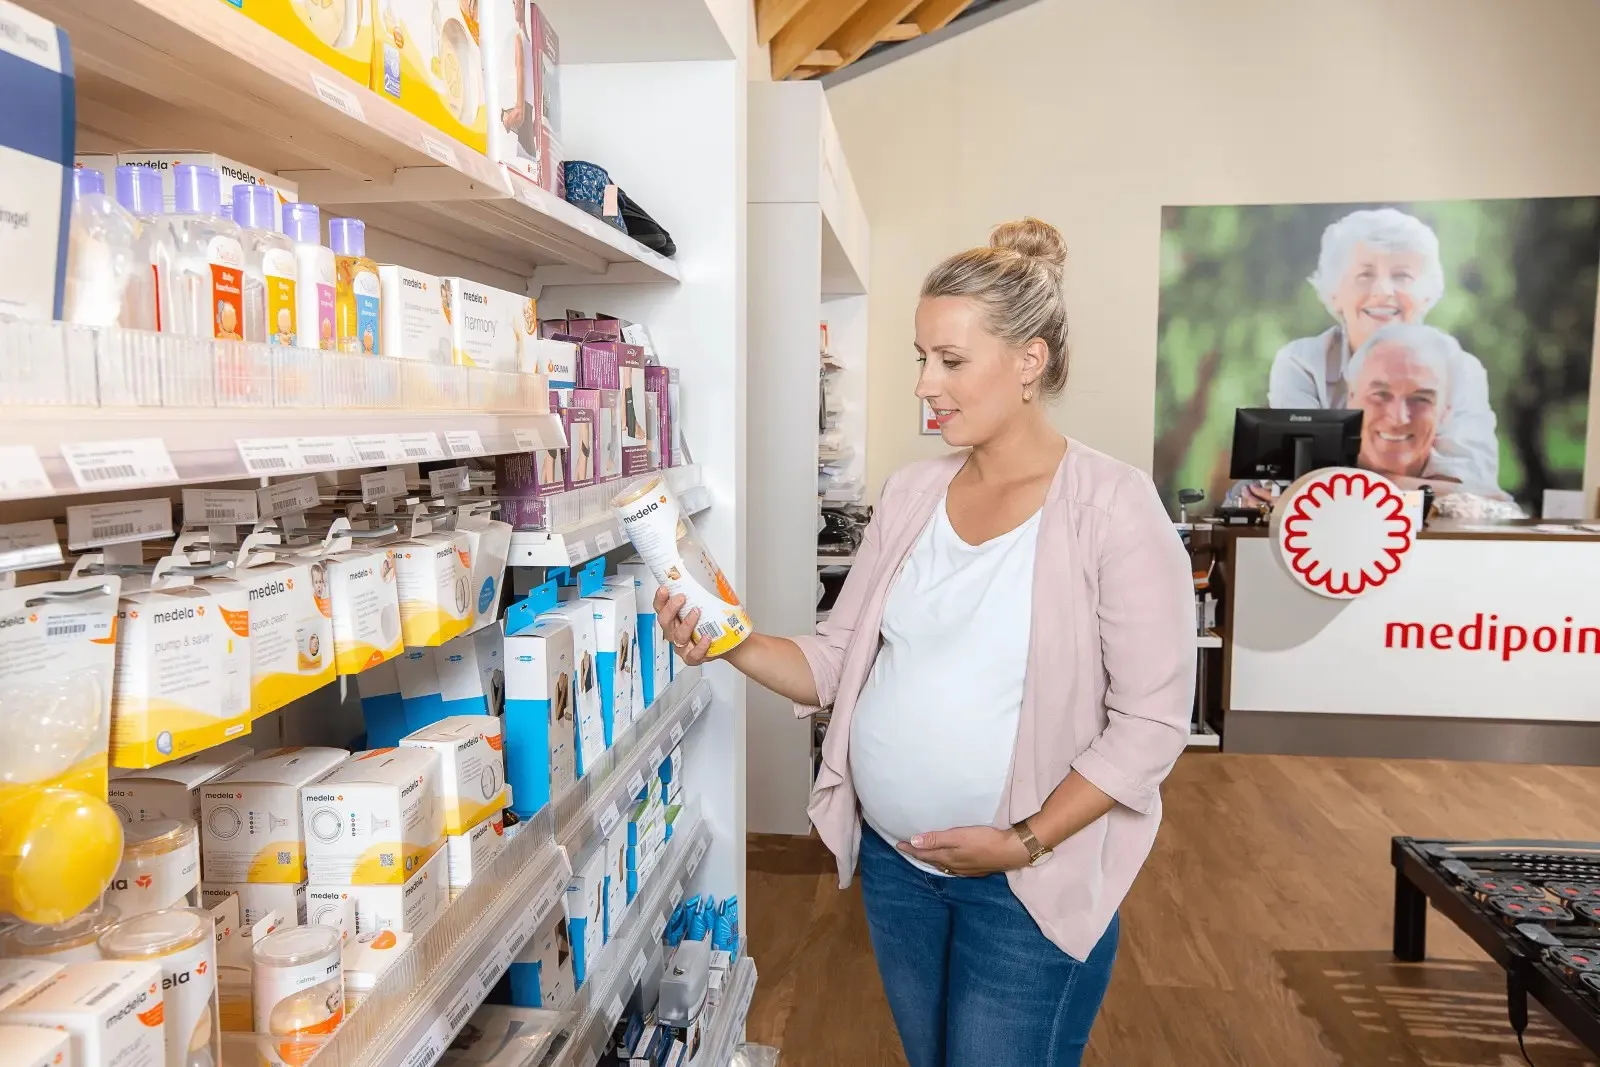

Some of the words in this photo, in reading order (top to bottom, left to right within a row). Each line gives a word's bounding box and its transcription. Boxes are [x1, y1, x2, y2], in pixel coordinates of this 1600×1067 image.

[221, 164, 256, 185] medela
[402, 278, 422, 290] medela
[463, 291, 483, 304] medela
[464, 312, 497, 338] harmony
[624, 502, 659, 524] medela
[436, 546, 453, 559] medela
[349, 568, 369, 580] medela
[249, 580, 285, 601] medela
[154, 607, 194, 624] medela
[1385, 612, 1600, 662] medipoin
[458, 736, 479, 752] medela
[401, 780, 419, 798] medela
[306, 794, 335, 802] medela
[472, 825, 488, 842] medela
[202, 889, 231, 897] medela
[405, 876, 424, 897] medela
[310, 892, 339, 900] medela
[162, 970, 190, 990] ela
[106, 992, 147, 1029] medela
